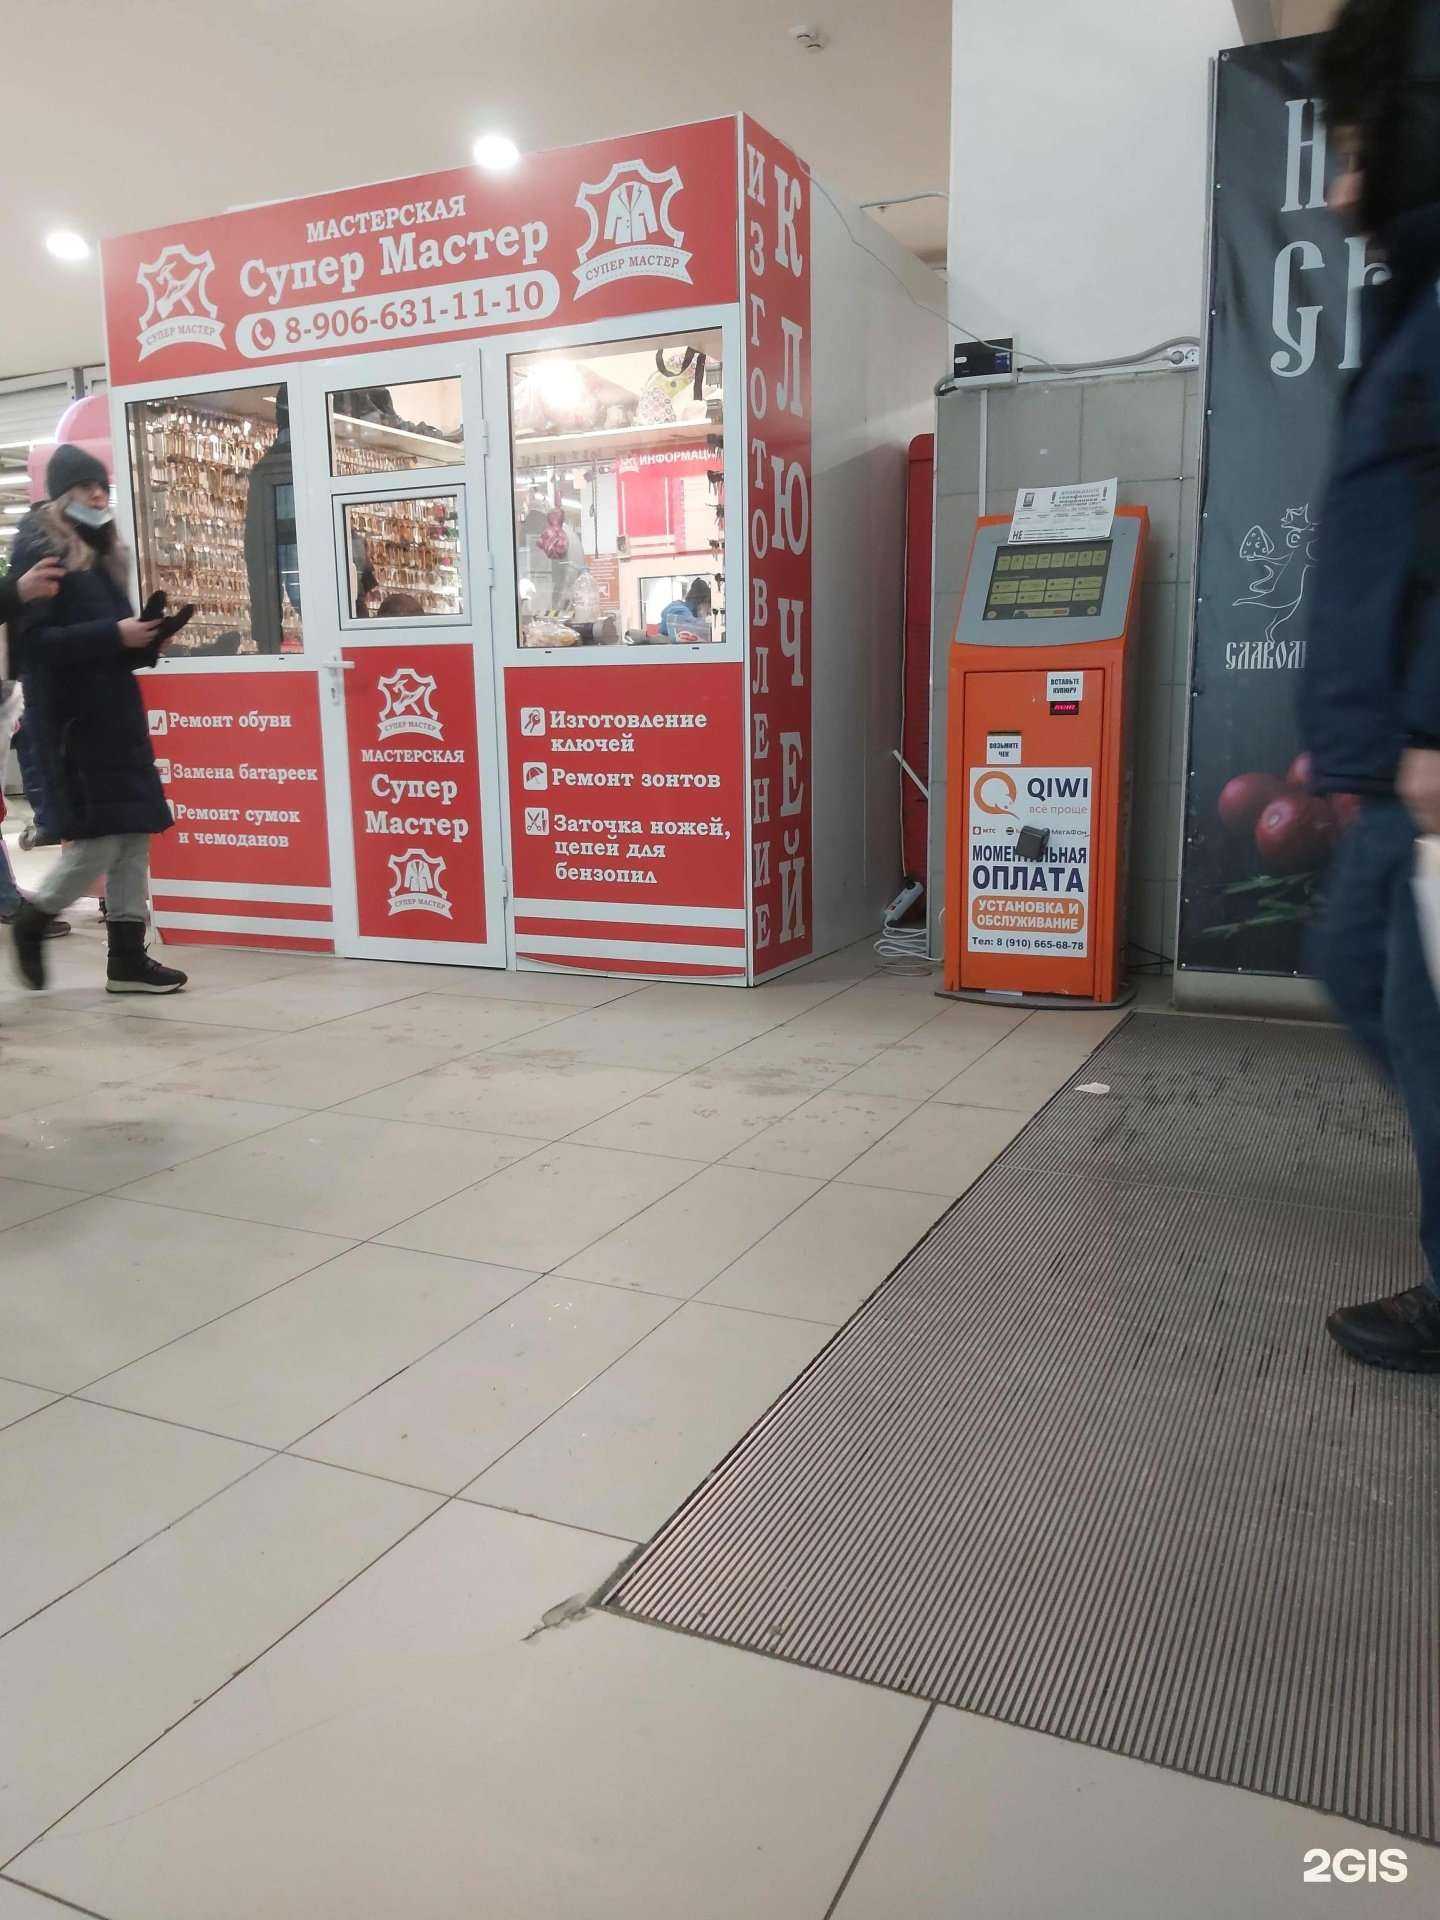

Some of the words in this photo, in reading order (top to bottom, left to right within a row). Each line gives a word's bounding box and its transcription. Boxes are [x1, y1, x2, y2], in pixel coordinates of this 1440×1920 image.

[306, 195, 466, 244] МАСТЕРСКАЯ
[240, 250, 365, 305] Супер
[379, 220, 549, 277] Мастер
[585, 258, 625, 282] СУПЕР
[629, 254, 680, 269] МАСТЕР
[285, 279, 544, 344] 8-906-631-11-10
[146, 326, 176, 346] СУПЕР
[177, 324, 215, 337] МАСТЕР
[747, 143, 771, 950] ИЗГОТОВЛЕНИЕ
[771, 164, 809, 944] КЛЮЧЕЙ
[1225, 640, 1307, 669] СЛАВОЛ
[169, 712, 234, 728] Ремонт
[239, 710, 292, 732] обуви
[550, 710, 708, 729] Изготовление
[551, 733, 635, 752] ключей
[361, 749, 465, 763] МАСТЕРСКАЯ
[173, 763, 235, 780] Замена
[239, 763, 318, 784] батареек
[552, 768, 634, 787] Ремонт
[641, 773, 721, 788] зонтов
[371, 773, 459, 805] Супер
[1027, 777, 1088, 801] QIWI
[176, 804, 240, 821] Ремонт
[245, 807, 301, 826] сумок
[1051, 806, 1088, 816] проще
[365, 810, 469, 843] Мастер
[554, 814, 643, 834] Заточка
[650, 816, 731, 840] ножей,
[178, 831, 189, 844] и
[194, 831, 290, 848] чемоданов
[555, 834, 619, 857] цепей
[626, 843, 667, 858] для
[555, 861, 658, 884] бензопил
[972, 865, 1084, 892] ОПЛАТА
[978, 899, 1064, 915] УСТАНОВКА
[1069, 902, 1079, 914] И
[976, 914, 1079, 930] ОБСЛУЖИВАНИЕ
[972, 936, 995, 946] Тел:
[996, 937, 1003, 946] 8
[1005, 937, 1031, 949] (910)
[1033, 939, 1084, 950] 665-68-78
